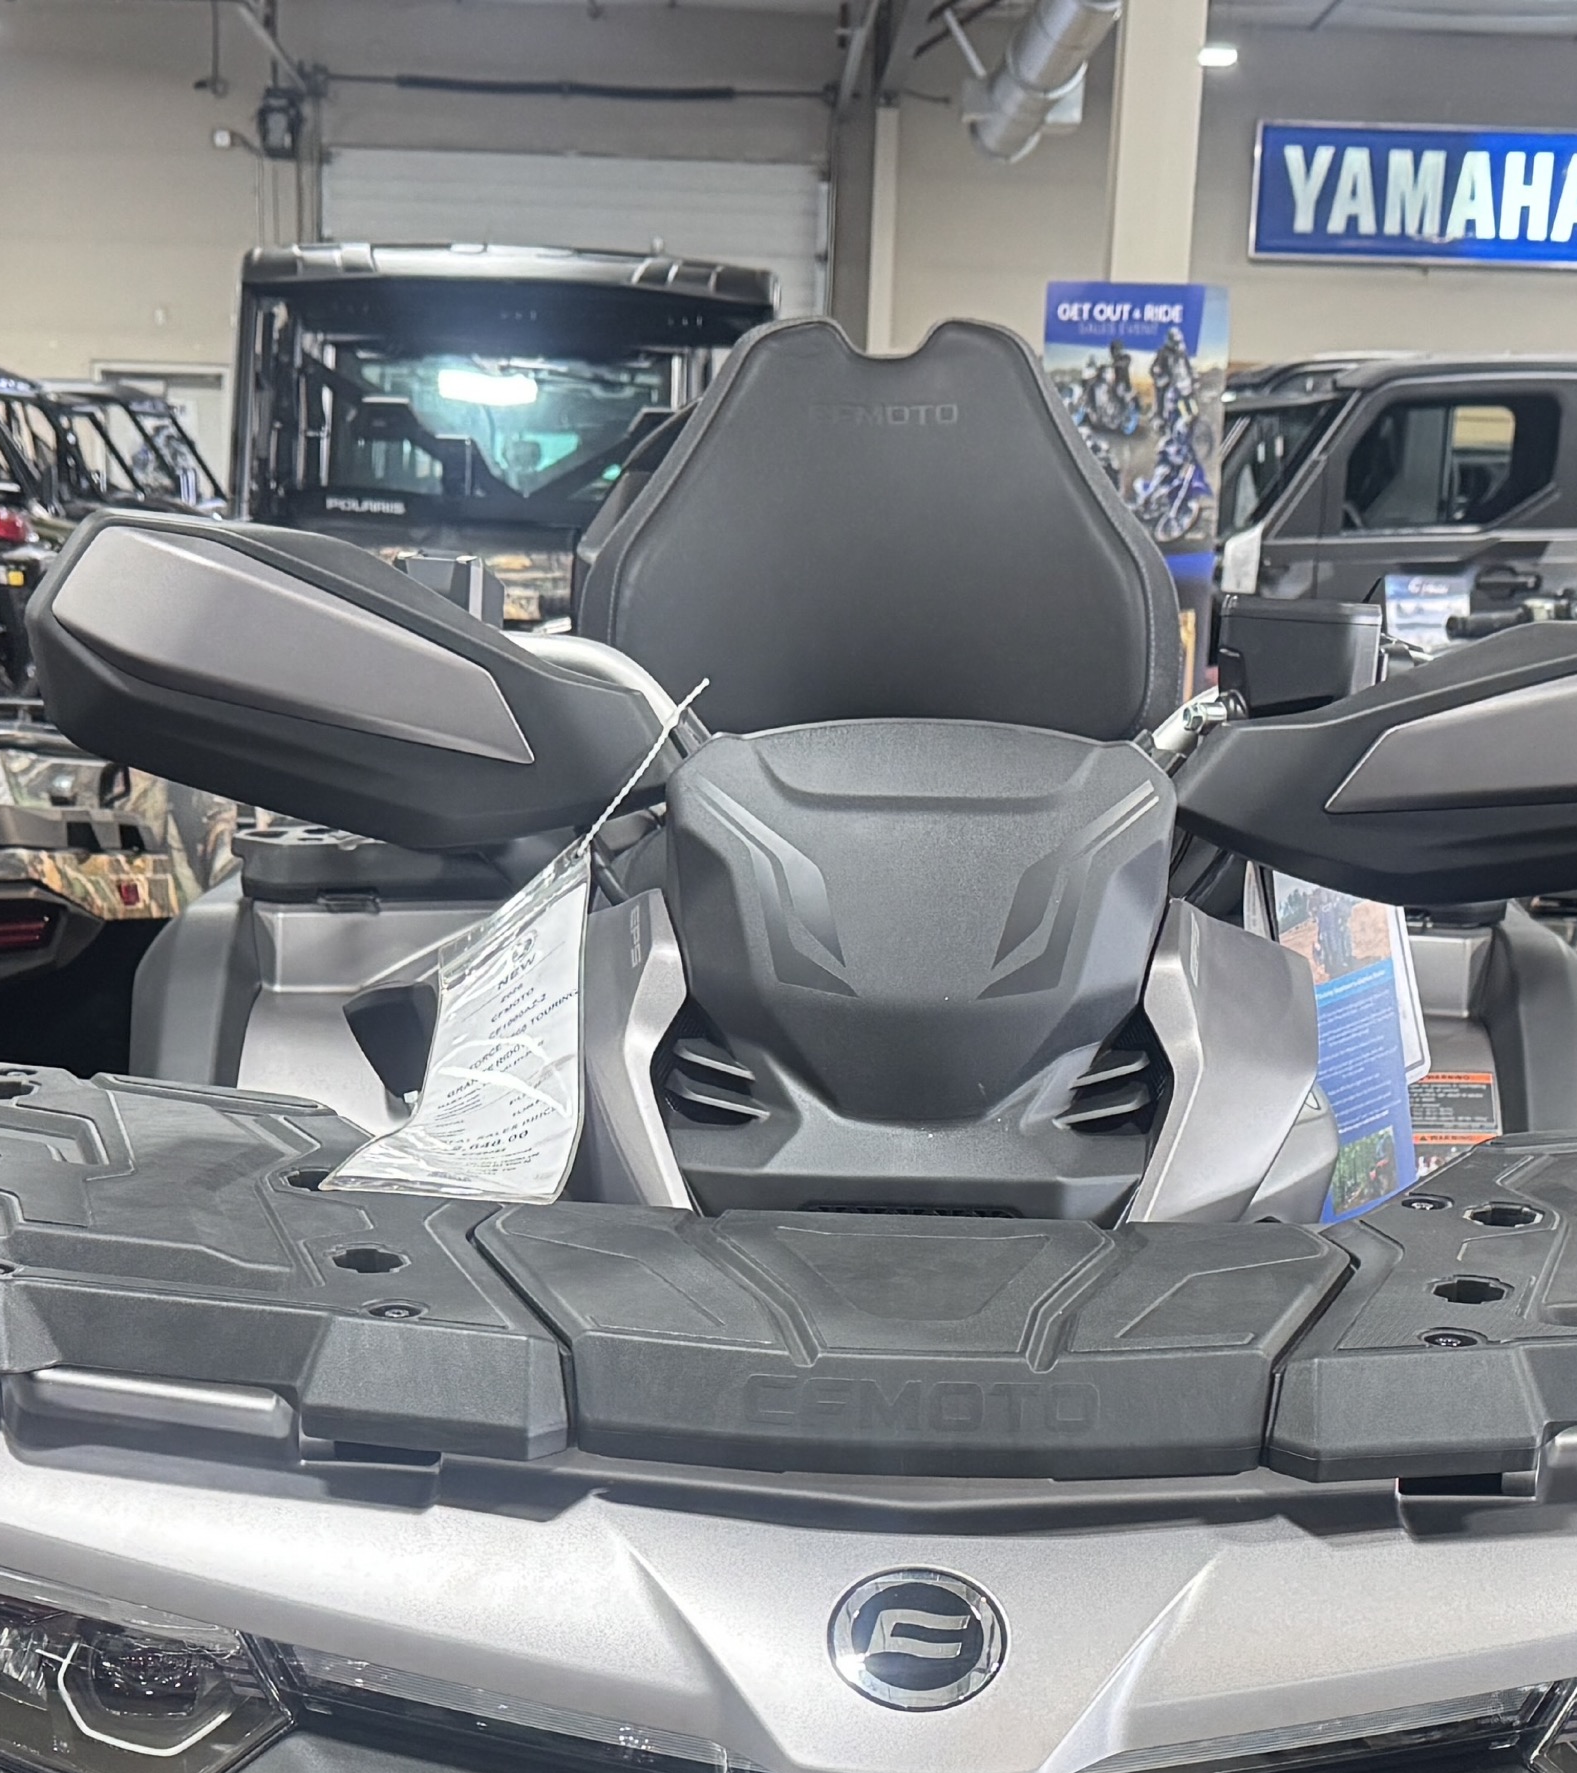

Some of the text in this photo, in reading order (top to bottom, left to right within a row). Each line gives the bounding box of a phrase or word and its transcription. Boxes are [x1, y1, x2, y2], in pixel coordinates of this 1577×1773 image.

[1057, 303, 1091, 322] GET
[1093, 303, 1131, 322] OUT
[1144, 304, 1183, 323] RIDE
[630, 904, 642, 968] EPS
[497, 953, 536, 990] NEW
[490, 987, 534, 1023] CFMOTO
[743, 1373, 1101, 1434] CFMOTO
